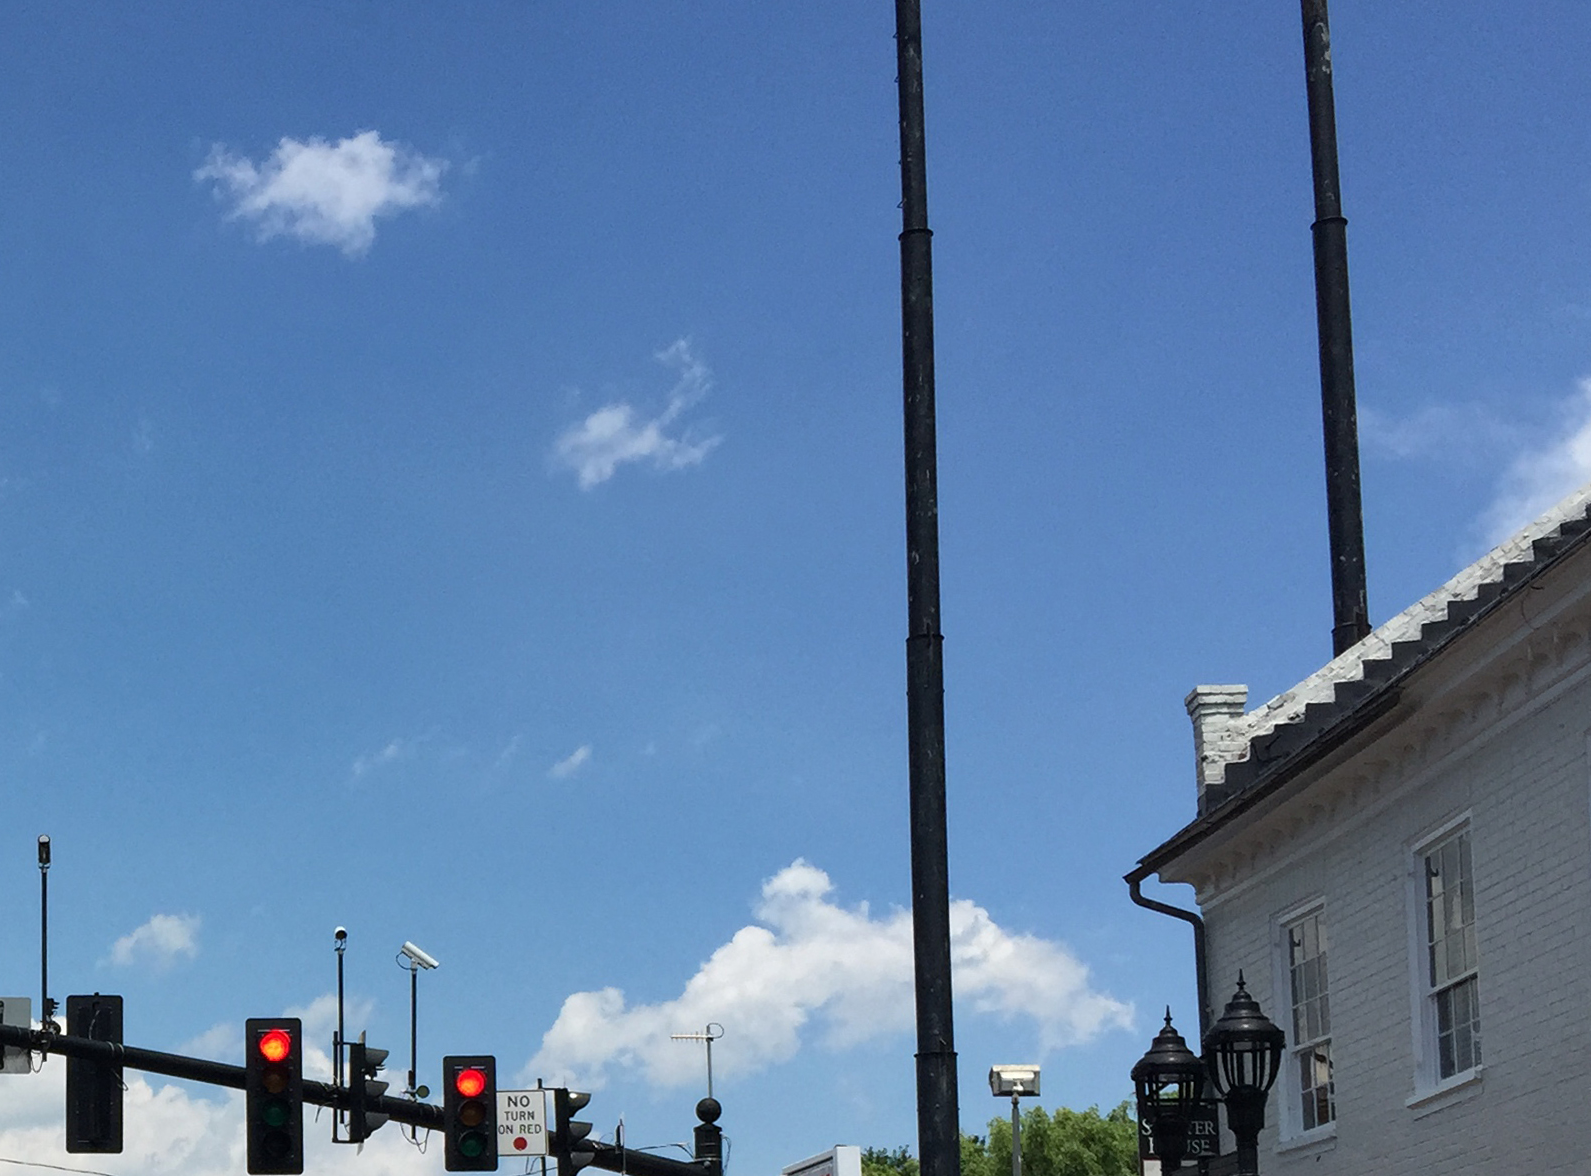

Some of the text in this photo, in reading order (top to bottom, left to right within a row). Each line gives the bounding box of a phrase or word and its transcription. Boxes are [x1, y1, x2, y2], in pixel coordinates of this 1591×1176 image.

[508, 1095, 530, 1108] NO
[504, 1111, 535, 1121] TURN
[498, 1124, 542, 1135] ON RED
